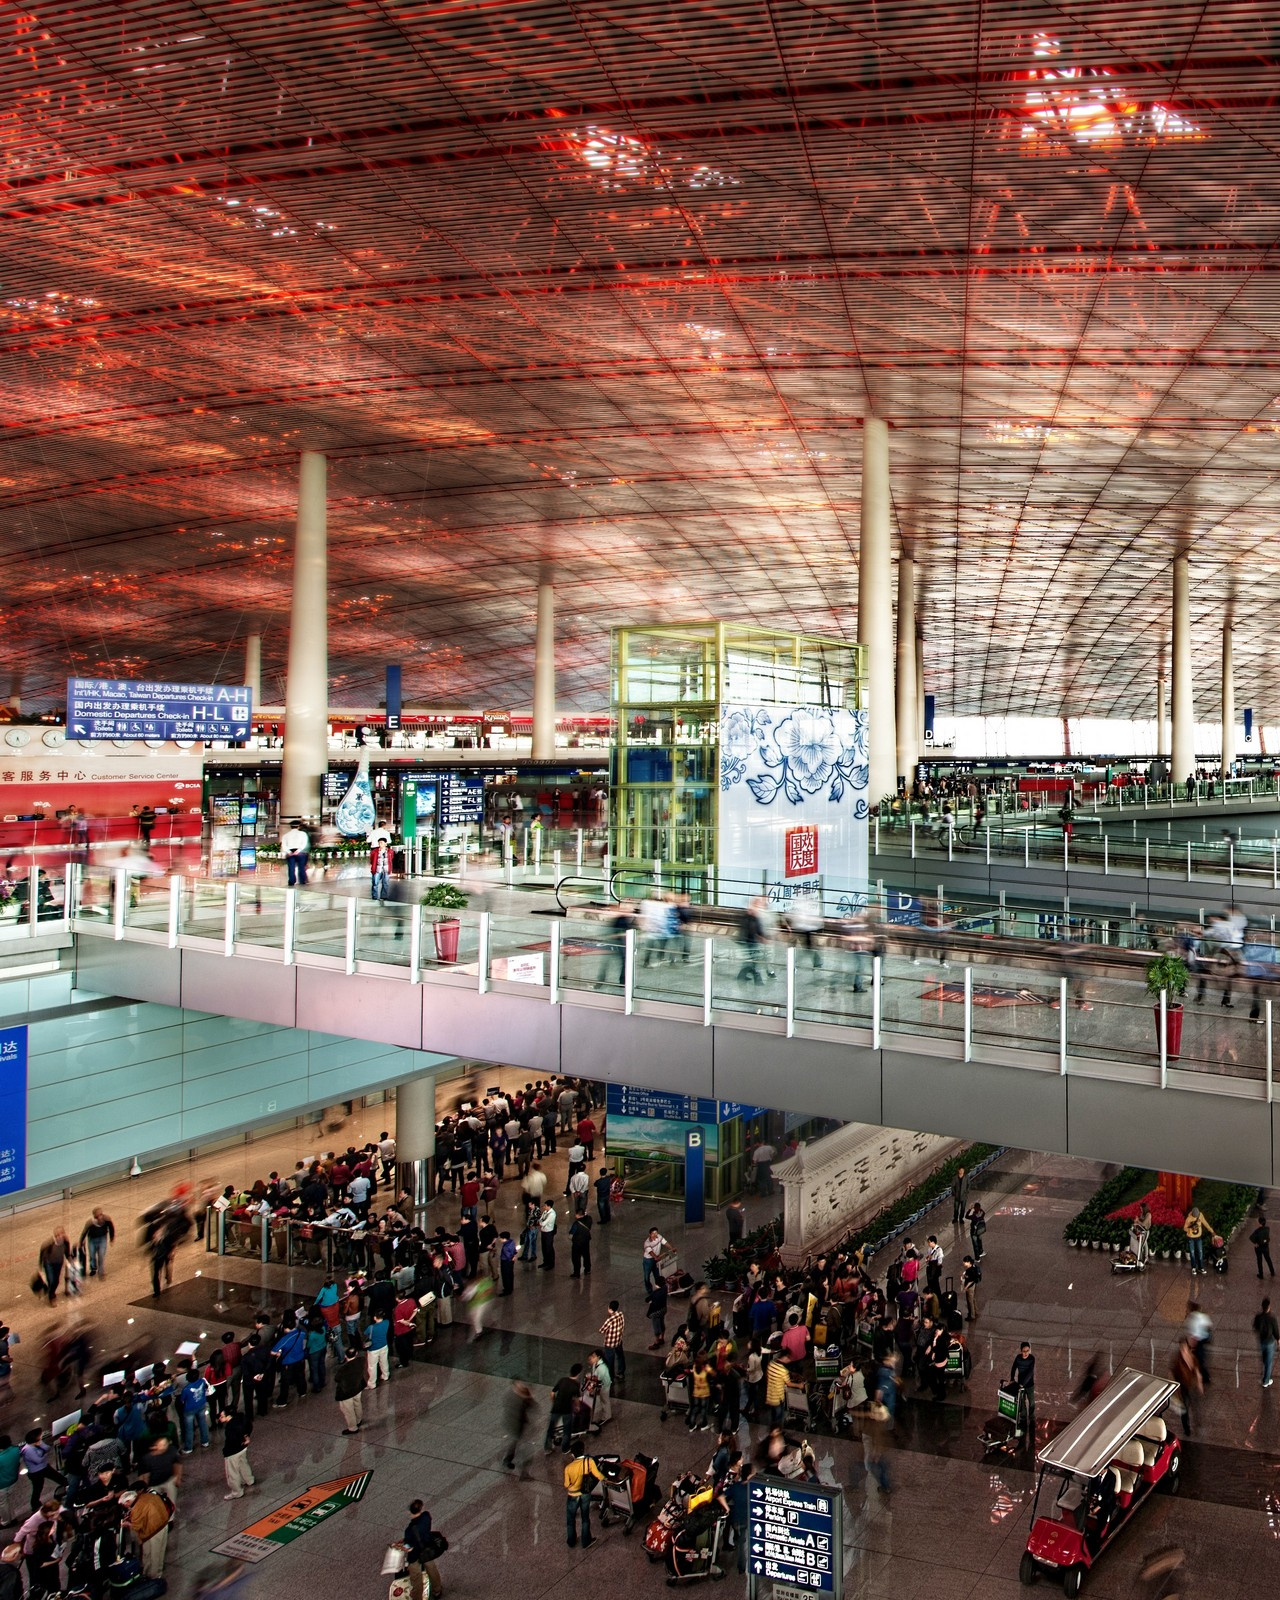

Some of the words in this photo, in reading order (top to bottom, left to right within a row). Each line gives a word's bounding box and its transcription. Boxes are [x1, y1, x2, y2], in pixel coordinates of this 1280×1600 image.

[103, 690, 128, 698] Macao,
[152, 693, 187, 701] Departures
[216, 688, 248, 702] A-H
[75, 700, 165, 711] 国内出发办理乘机手续
[75, 710, 112, 718] Domestic
[114, 711, 156, 719] Departures
[158, 712, 190, 720] Check-in
[193, 705, 224, 720] H-L
[388, 716, 398, 728] E
[925, 730, 933, 739] D
[2, 770, 87, 782] 客服务中心
[91, 773, 127, 781] Customer
[898, 892, 913, 910] D
[0, 1041, 18, 1054] 达
[688, 1133, 701, 1147] B
[765, 1494, 783, 1504] Airport
[782, 1497, 804, 1508] Express
[803, 1501, 817, 1511] Train
[765, 1511, 786, 1524] Parking
[765, 1531, 788, 1542] Domestic
[805, 1533, 815, 1548] A
[806, 1552, 816, 1567] B
[765, 1569, 796, 1582] Departures
